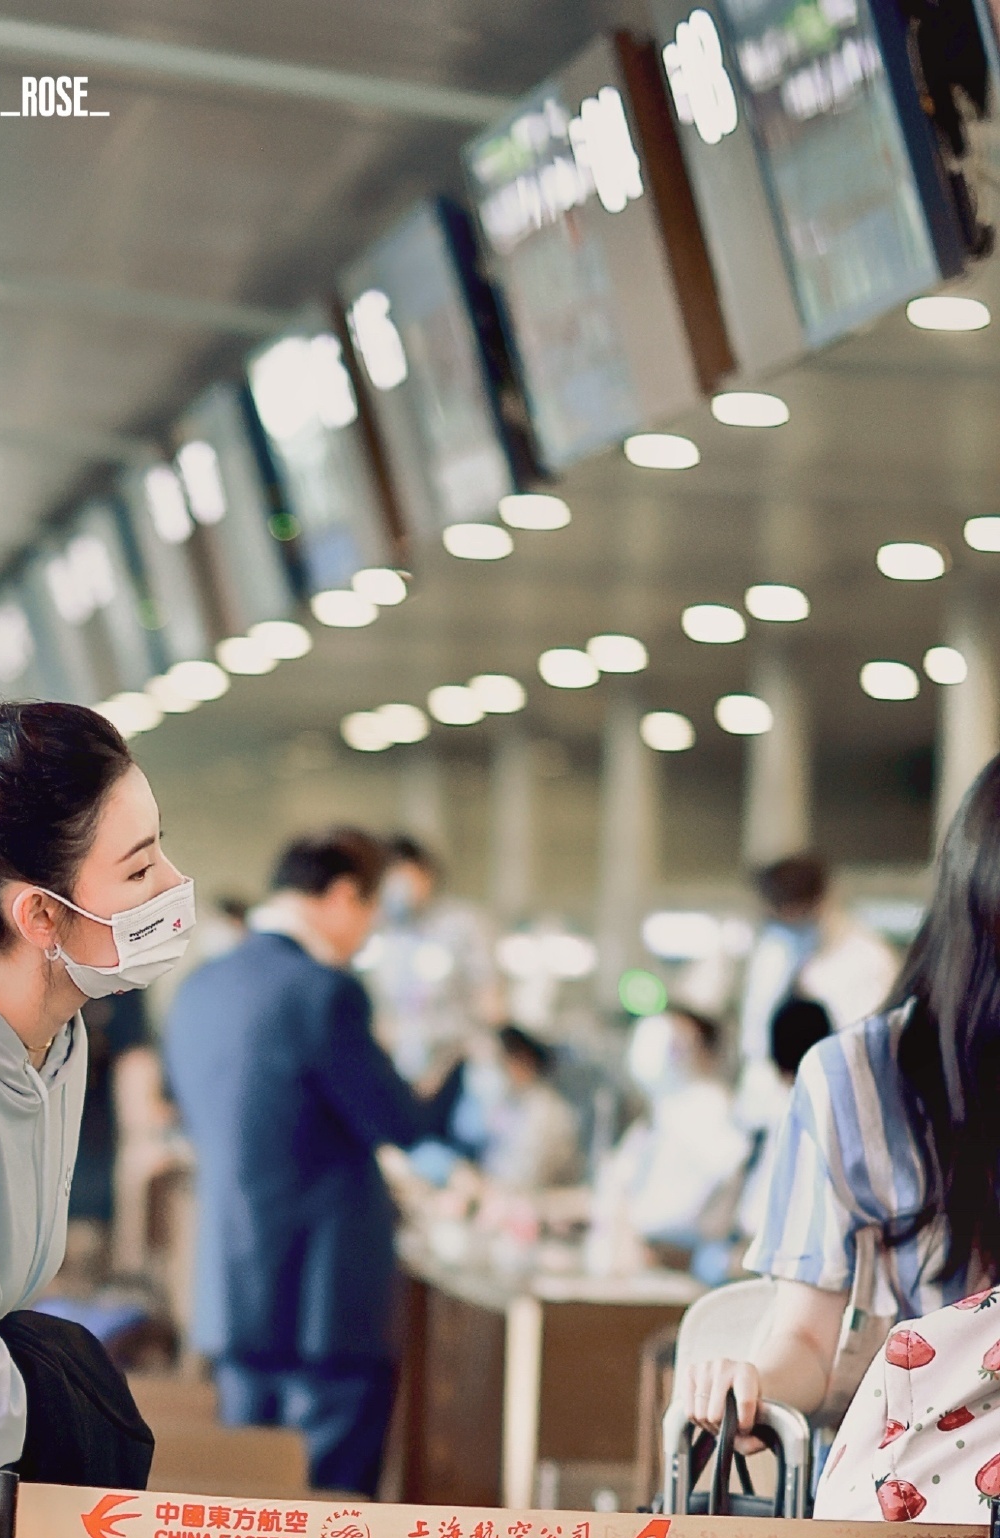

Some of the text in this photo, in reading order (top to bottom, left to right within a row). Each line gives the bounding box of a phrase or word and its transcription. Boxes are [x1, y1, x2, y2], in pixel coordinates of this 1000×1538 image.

[155, 1502, 309, 1533] 中國東方航空
